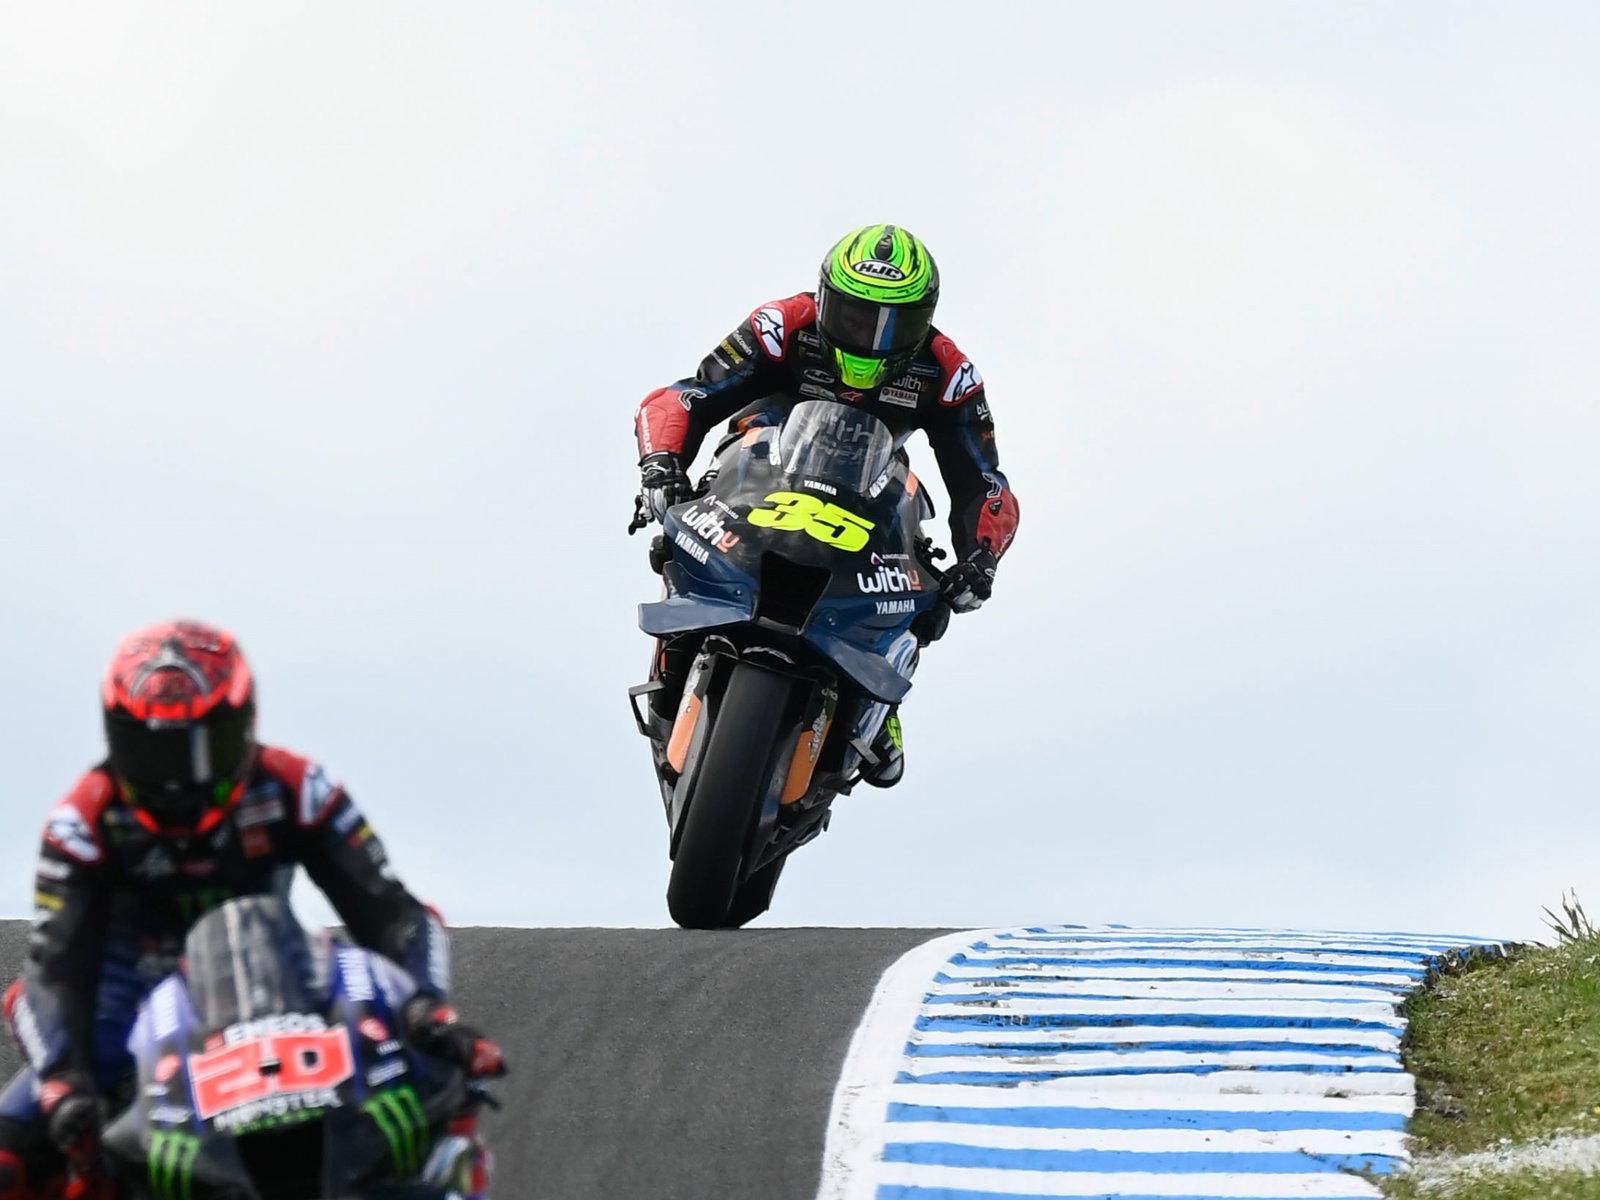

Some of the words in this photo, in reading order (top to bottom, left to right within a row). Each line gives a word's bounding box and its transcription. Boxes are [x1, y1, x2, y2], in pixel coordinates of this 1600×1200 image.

[858, 263, 900, 279] HJC
[803, 479, 838, 496] YAMAHA
[747, 491, 876, 552] 35
[674, 530, 710, 566] YAMAHA
[875, 598, 916, 615] YAMAHA
[188, 1022, 357, 1120] 20
